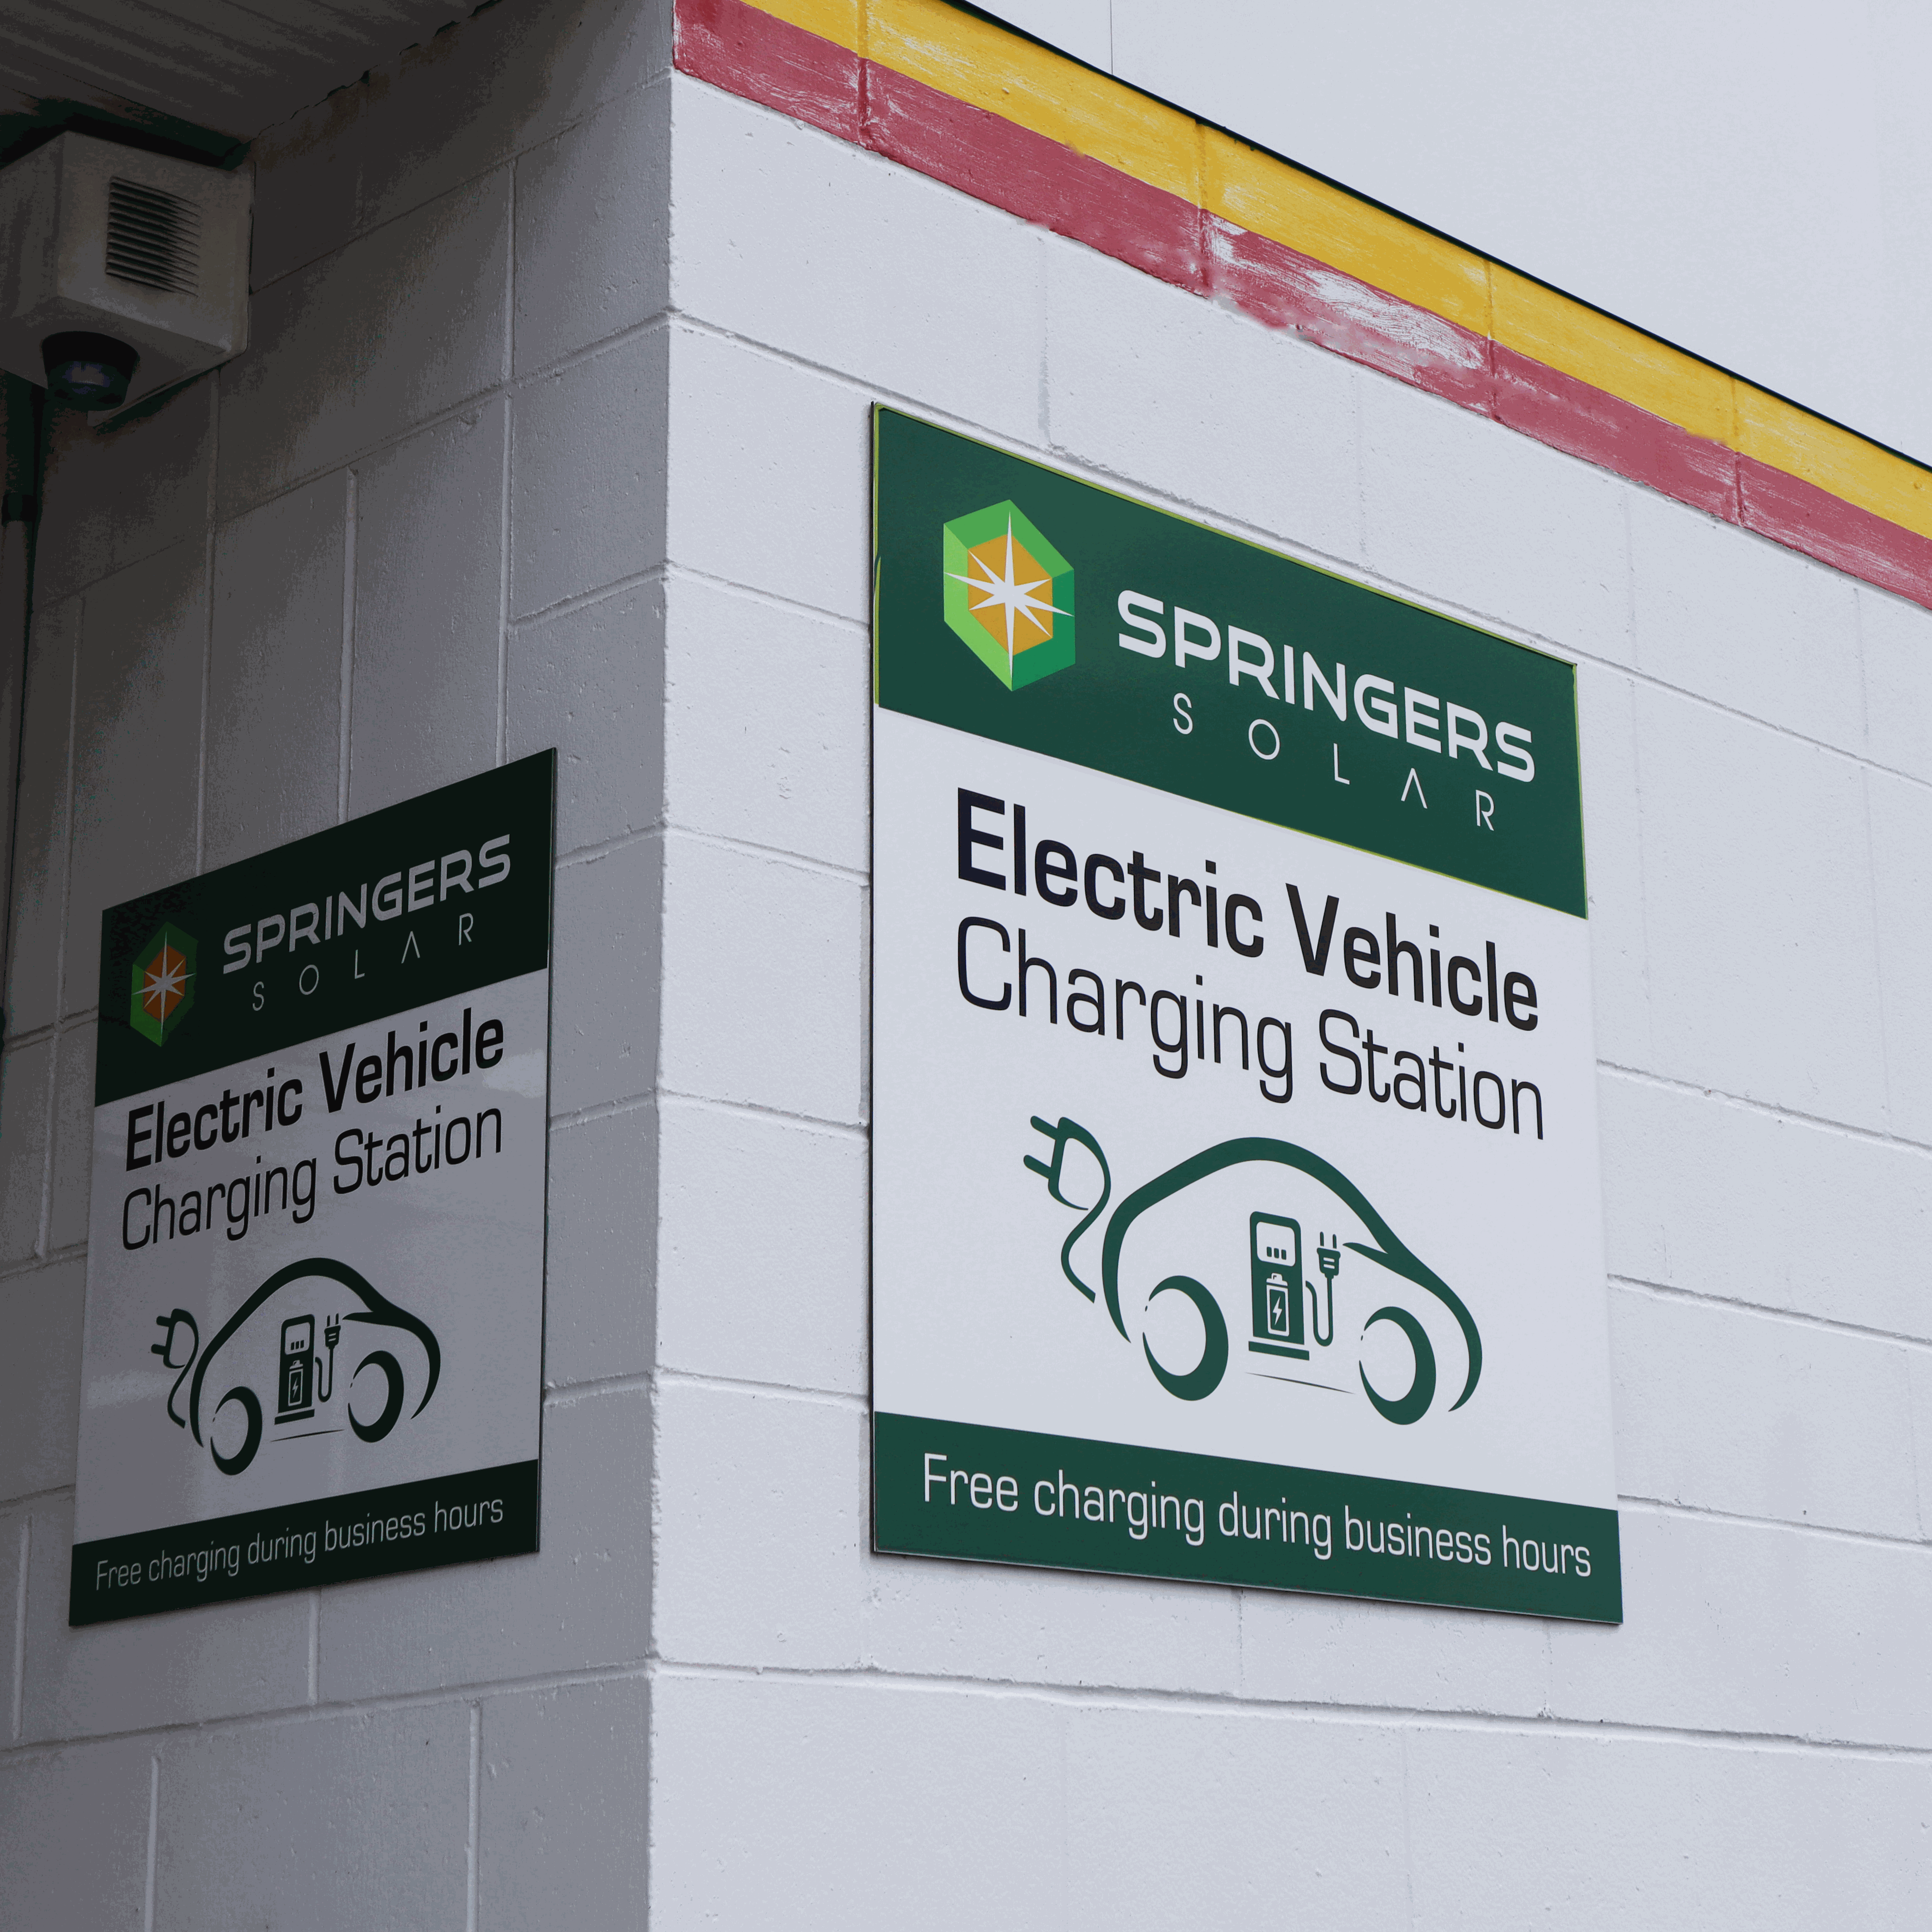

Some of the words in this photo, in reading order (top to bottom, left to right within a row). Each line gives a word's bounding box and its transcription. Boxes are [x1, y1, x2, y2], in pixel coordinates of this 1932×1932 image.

[1117, 590, 1535, 782] SPRINGERS
[1173, 692, 1494, 831] SOLAR
[223, 834, 511, 974] SPRINGERS
[253, 912, 474, 1011] SOLAR
[957, 787, 1264, 958] Electric
[1285, 882, 1538, 1031] Vehicle
[126, 1066, 303, 1172] Electric
[319, 1007, 504, 1113] Vehicle
[957, 916, 1293, 1104] Charging
[1319, 1009, 1543, 1140] Station
[123, 1155, 317, 1250] Charging
[333, 1105, 502, 1194] Station
[97, 1560, 142, 1591] Free
[149, 1541, 240, 1582] charging
[248, 1527, 316, 1563] during
[324, 1512, 426, 1552] business
[434, 1498, 504, 1533] hours
[923, 1452, 1018, 1512] Free
[1034, 1469, 1204, 1546] charging
[1219, 1491, 1332, 1561] during
[1345, 1505, 1492, 1566] business
[1502, 1524, 1592, 1577] hours
